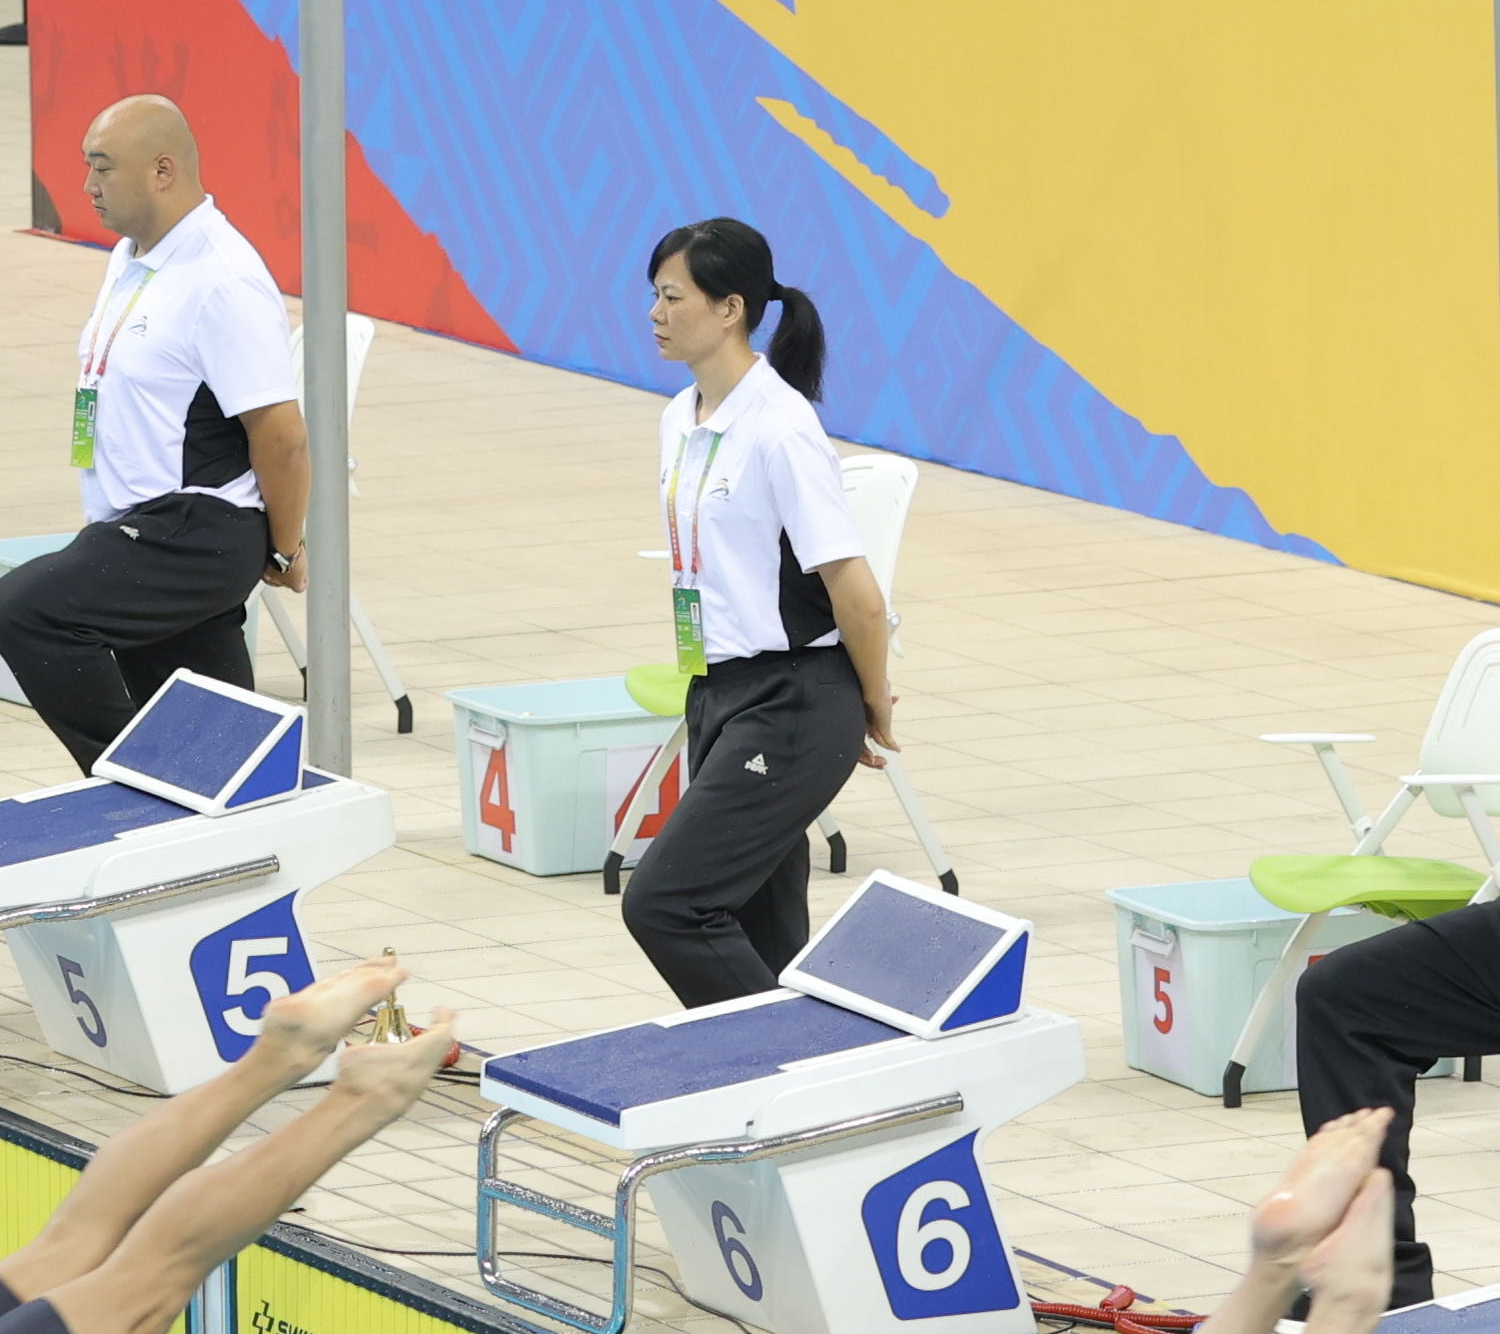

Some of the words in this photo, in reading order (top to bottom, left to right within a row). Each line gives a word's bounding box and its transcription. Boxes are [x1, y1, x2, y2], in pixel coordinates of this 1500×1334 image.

[480, 747, 517, 854] 4
[56, 955, 107, 1048] 5
[222, 936, 293, 1037] 5
[1151, 967, 1175, 1036] 5
[710, 1199, 763, 1303] 6
[896, 1179, 972, 1292] 6
